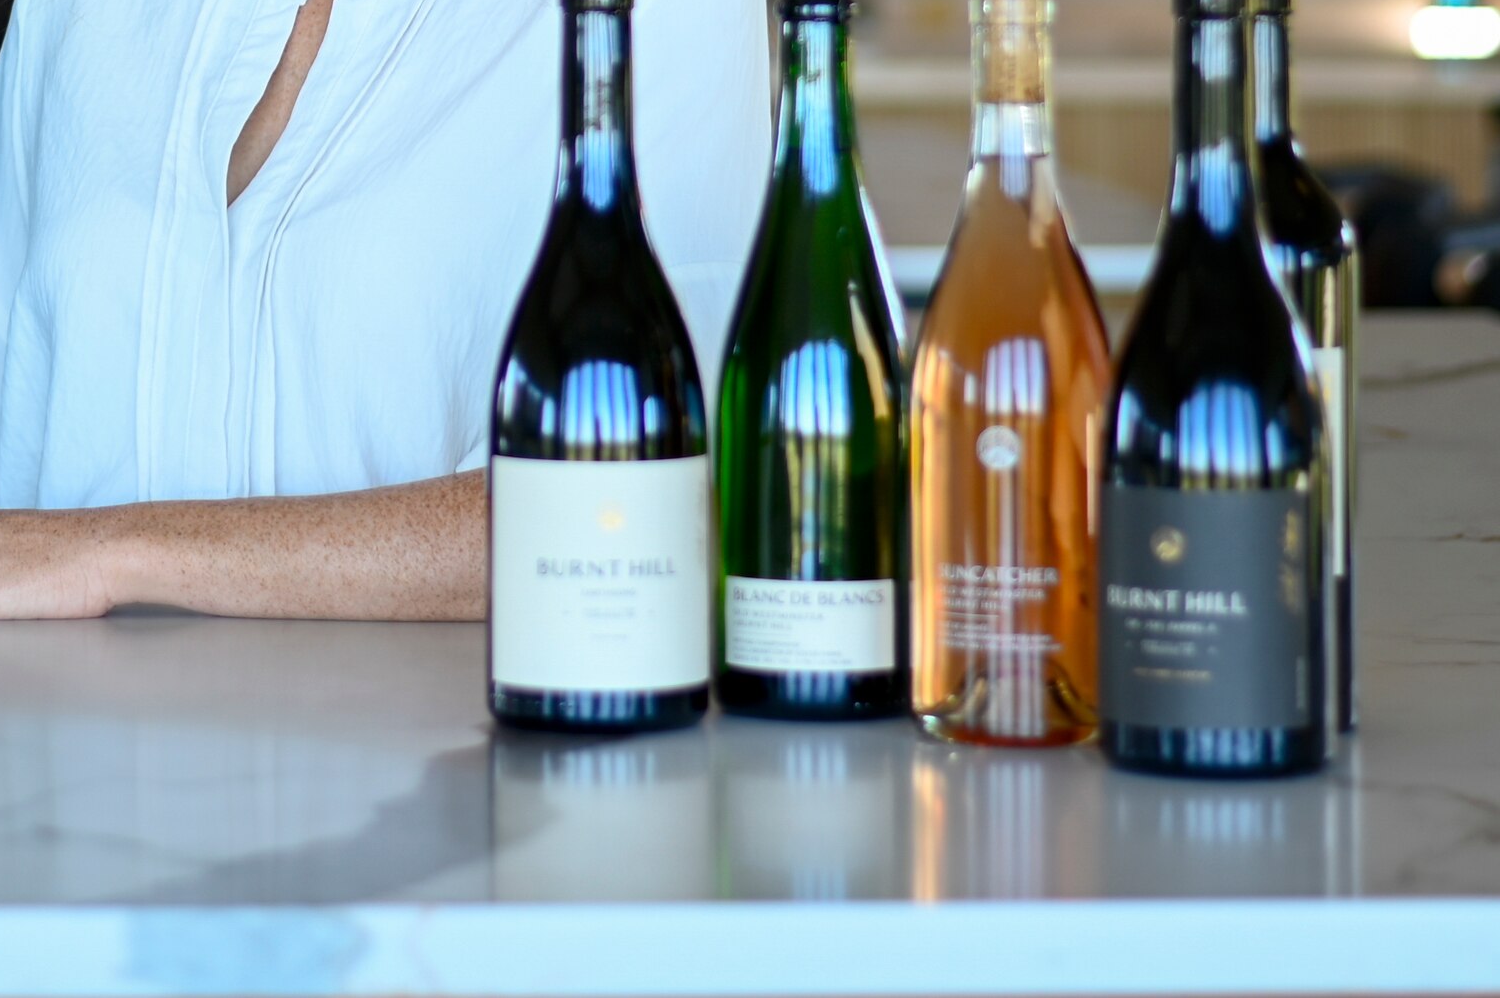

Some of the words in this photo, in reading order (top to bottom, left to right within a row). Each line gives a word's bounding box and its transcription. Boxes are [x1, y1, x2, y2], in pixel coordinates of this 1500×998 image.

[535, 555, 622, 577] BURNT
[628, 554, 677, 576] HILL
[732, 585, 786, 605] BLANC
[789, 590, 812, 605] DE
[817, 588, 886, 606] BLANCS
[1106, 583, 1181, 612] BURNT
[1184, 589, 1248, 615] HILL
